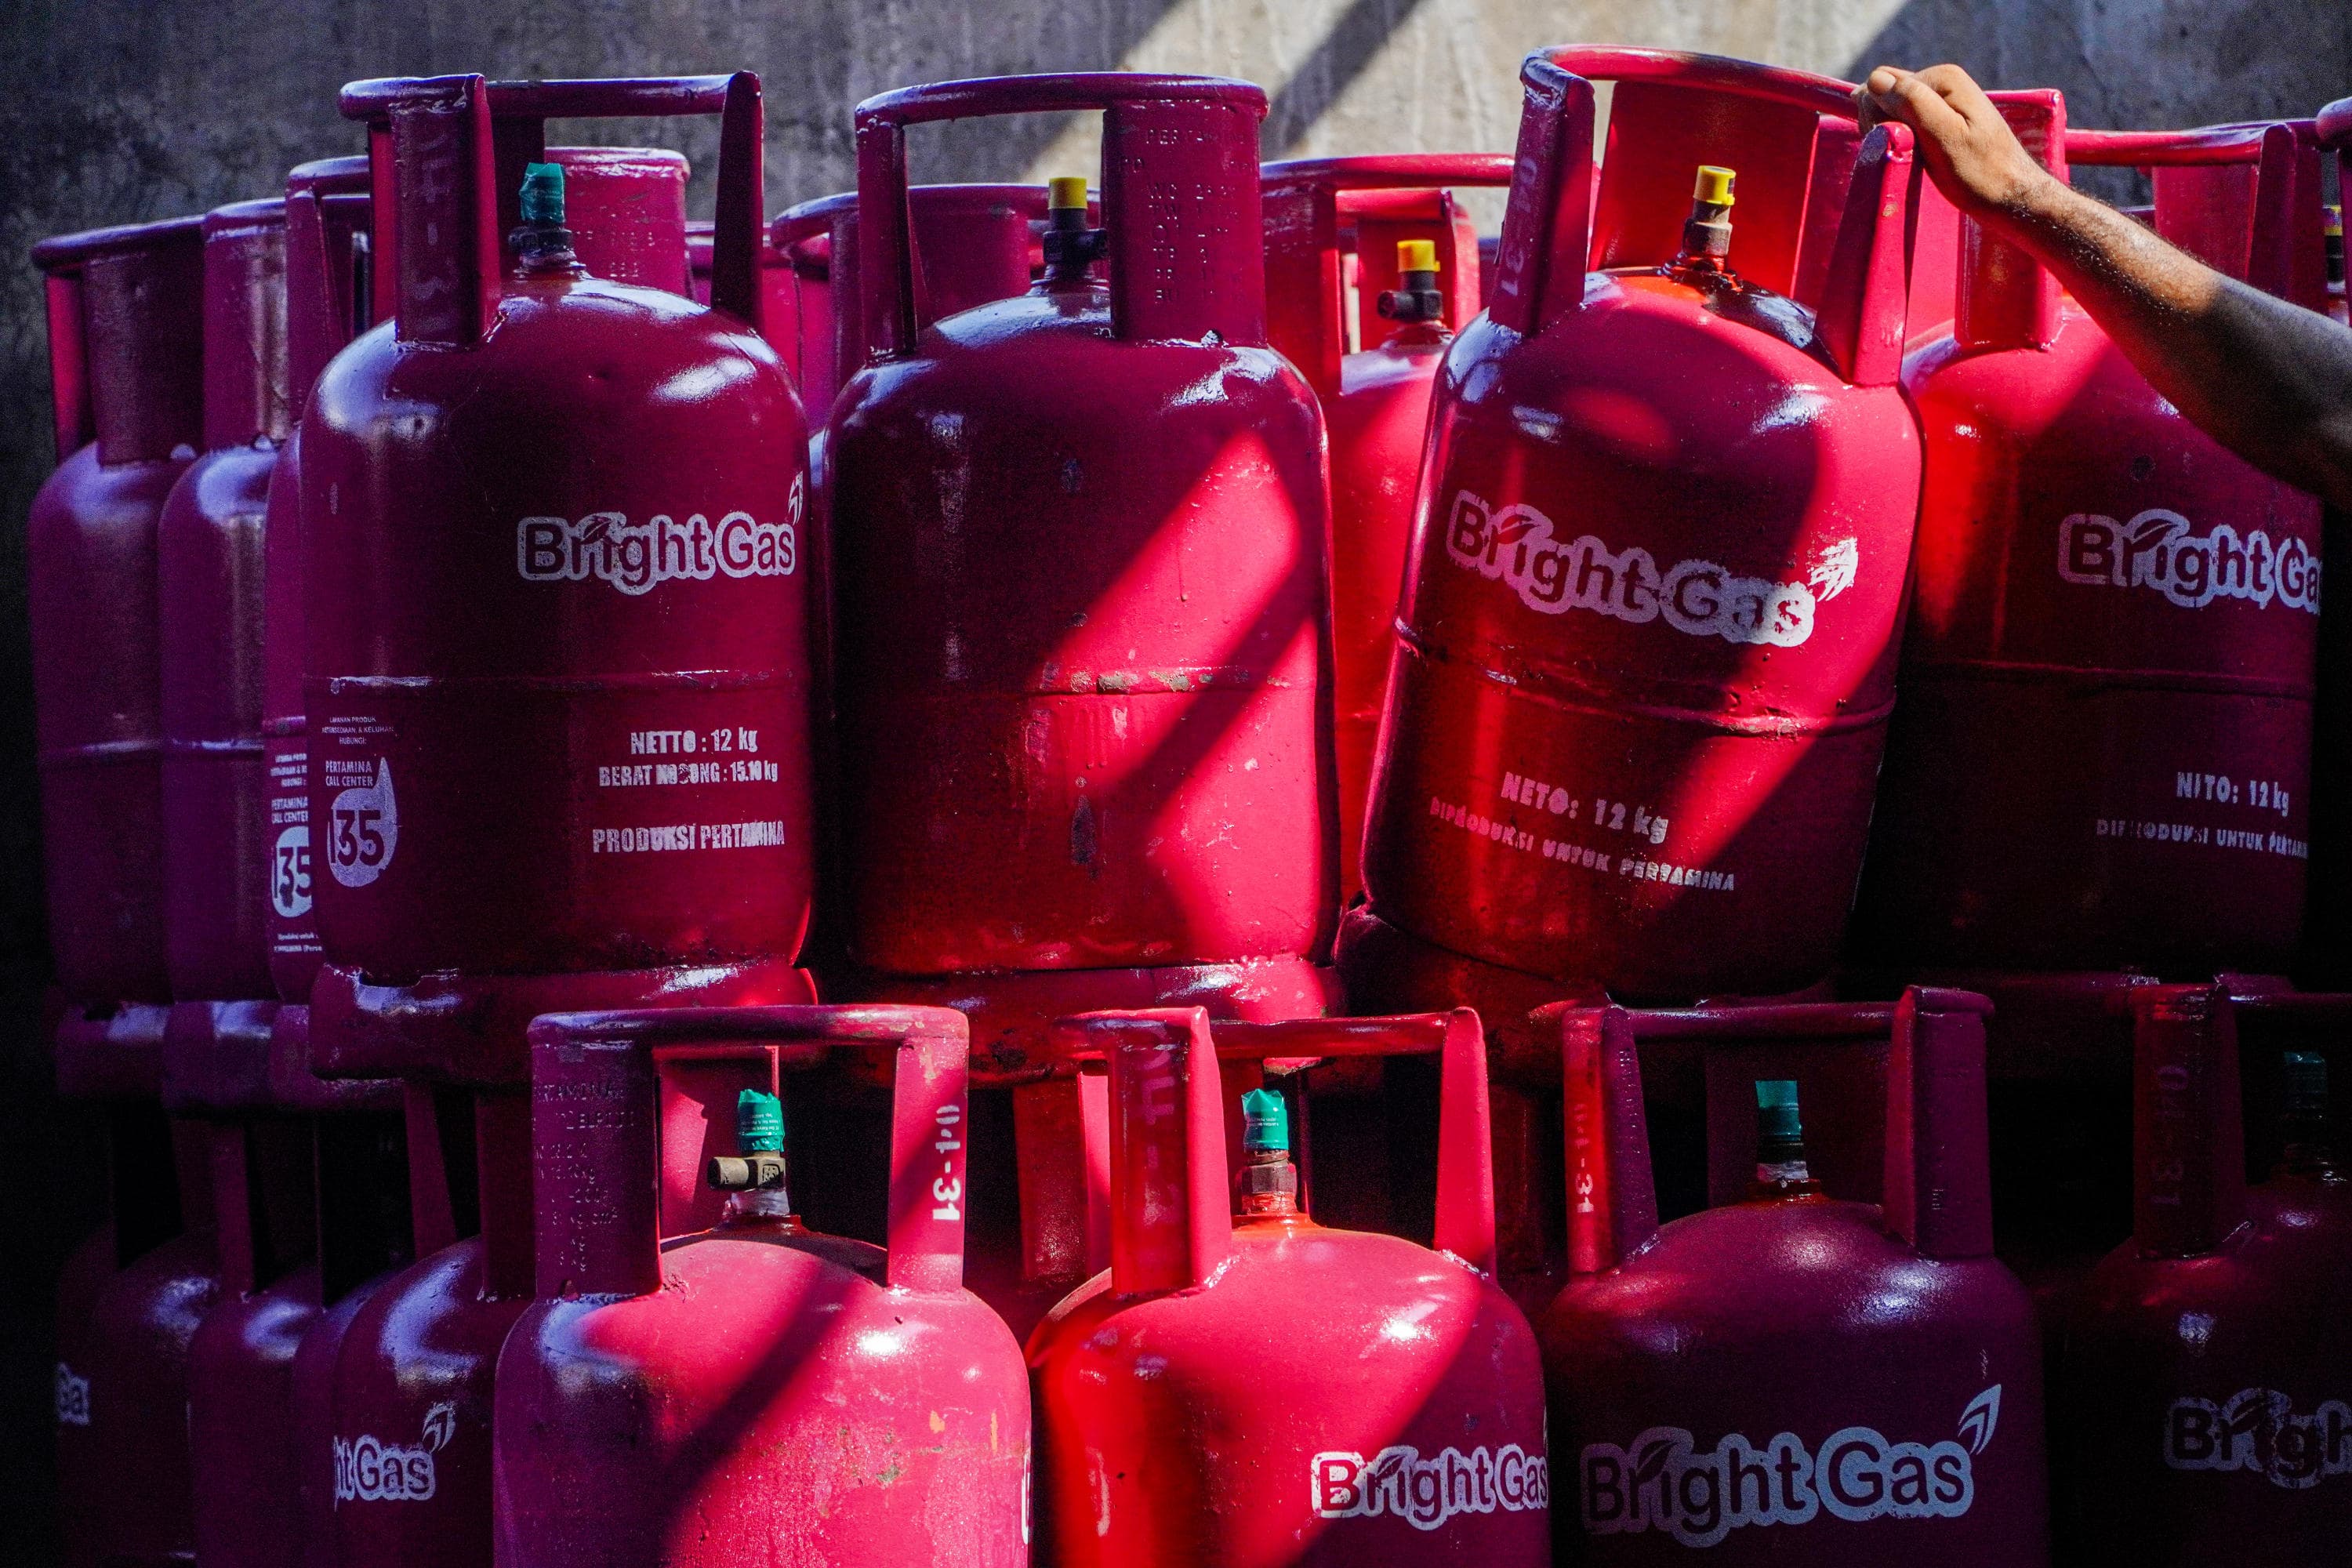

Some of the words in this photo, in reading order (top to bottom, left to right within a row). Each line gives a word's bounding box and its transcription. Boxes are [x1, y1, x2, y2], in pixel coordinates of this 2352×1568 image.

[630, 730, 696, 754] NETTO
[710, 728, 732, 752] 12
[738, 726, 758, 753] kg
[325, 760, 372, 773] PERTAMINA
[325, 775, 339, 786] CALL
[342, 775, 373, 786] CENTER
[599, 764, 652, 786] BERAT
[764, 760, 778, 782] kg
[2249, 779, 2268, 808] 12
[2274, 782, 2289, 817] kg
[1594, 798, 1626, 830] 12
[1633, 804, 1669, 844] kg
[329, 809, 385, 866] 135
[593, 823, 695, 854] PRODUKSI
[700, 820, 785, 849] PERTAMINA
[2216, 829, 2263, 851] UNTUK
[1620, 858, 1734, 891] PERTAMINA
